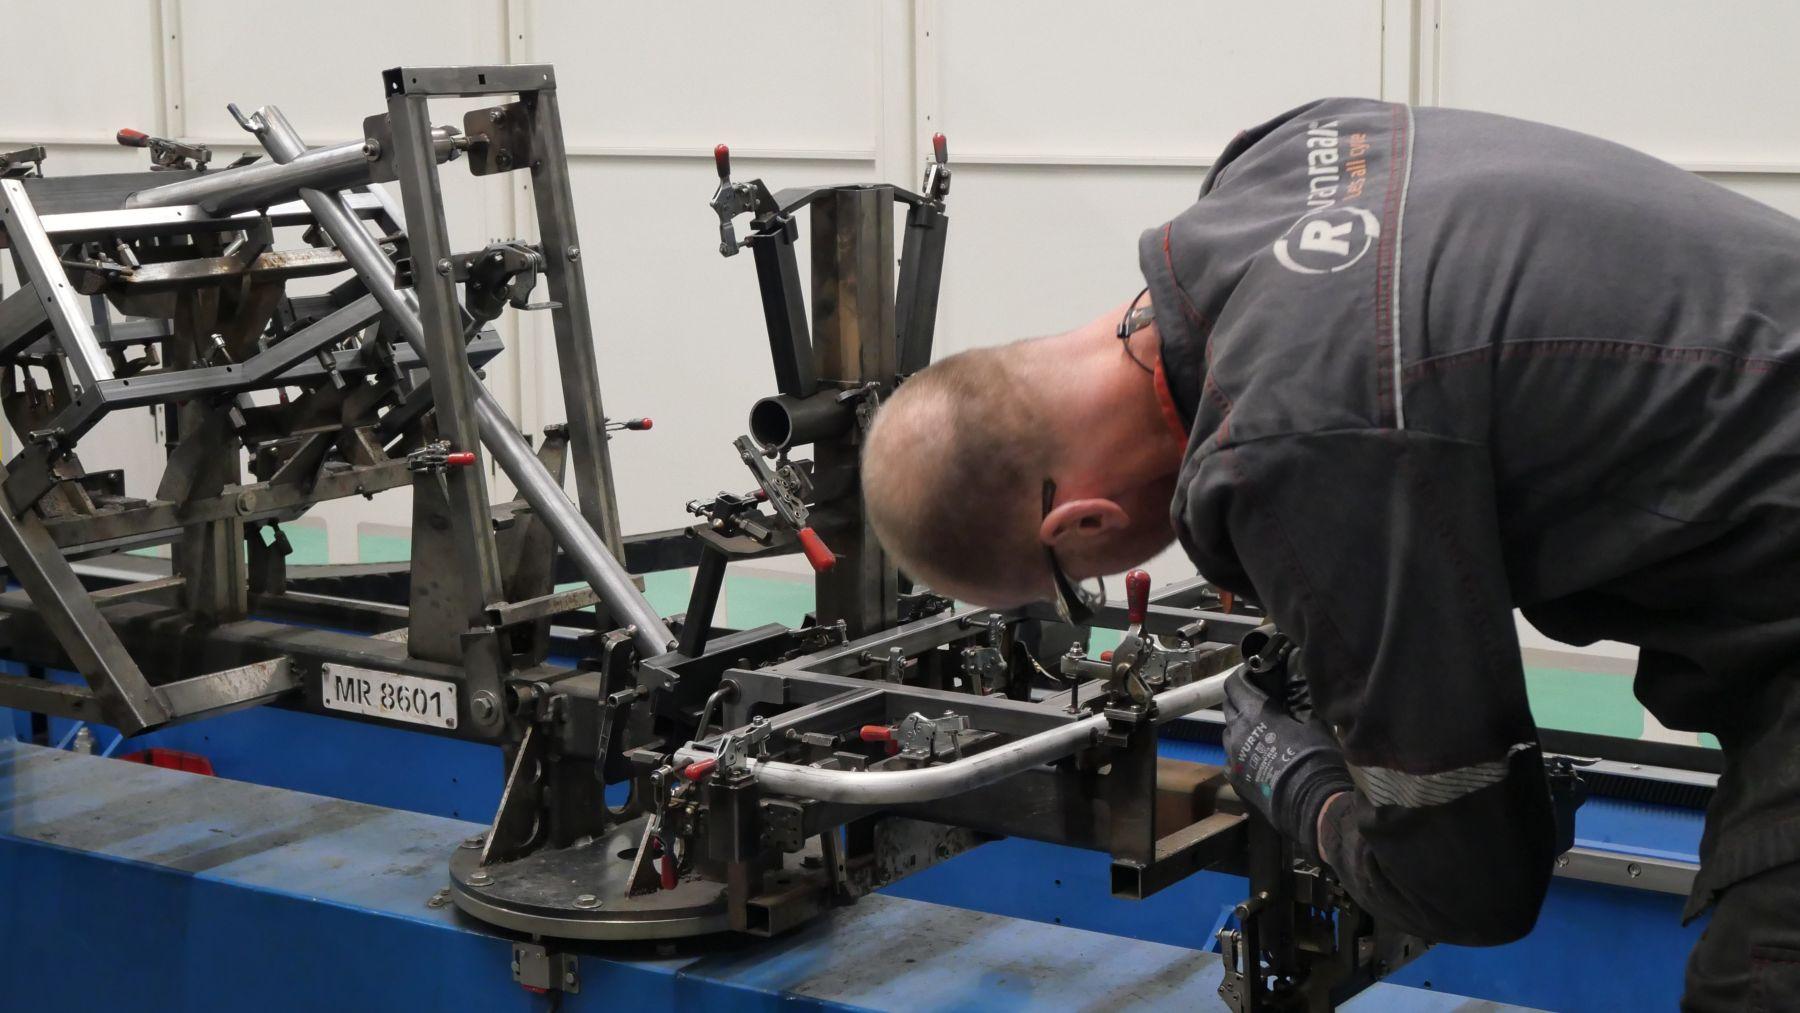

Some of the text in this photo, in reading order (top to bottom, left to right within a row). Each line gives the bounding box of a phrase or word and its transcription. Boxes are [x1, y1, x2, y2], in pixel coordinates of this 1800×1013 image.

[1345, 159, 1367, 177] all
[1299, 219, 1353, 256] R
[335, 675, 441, 717] MR 8601
